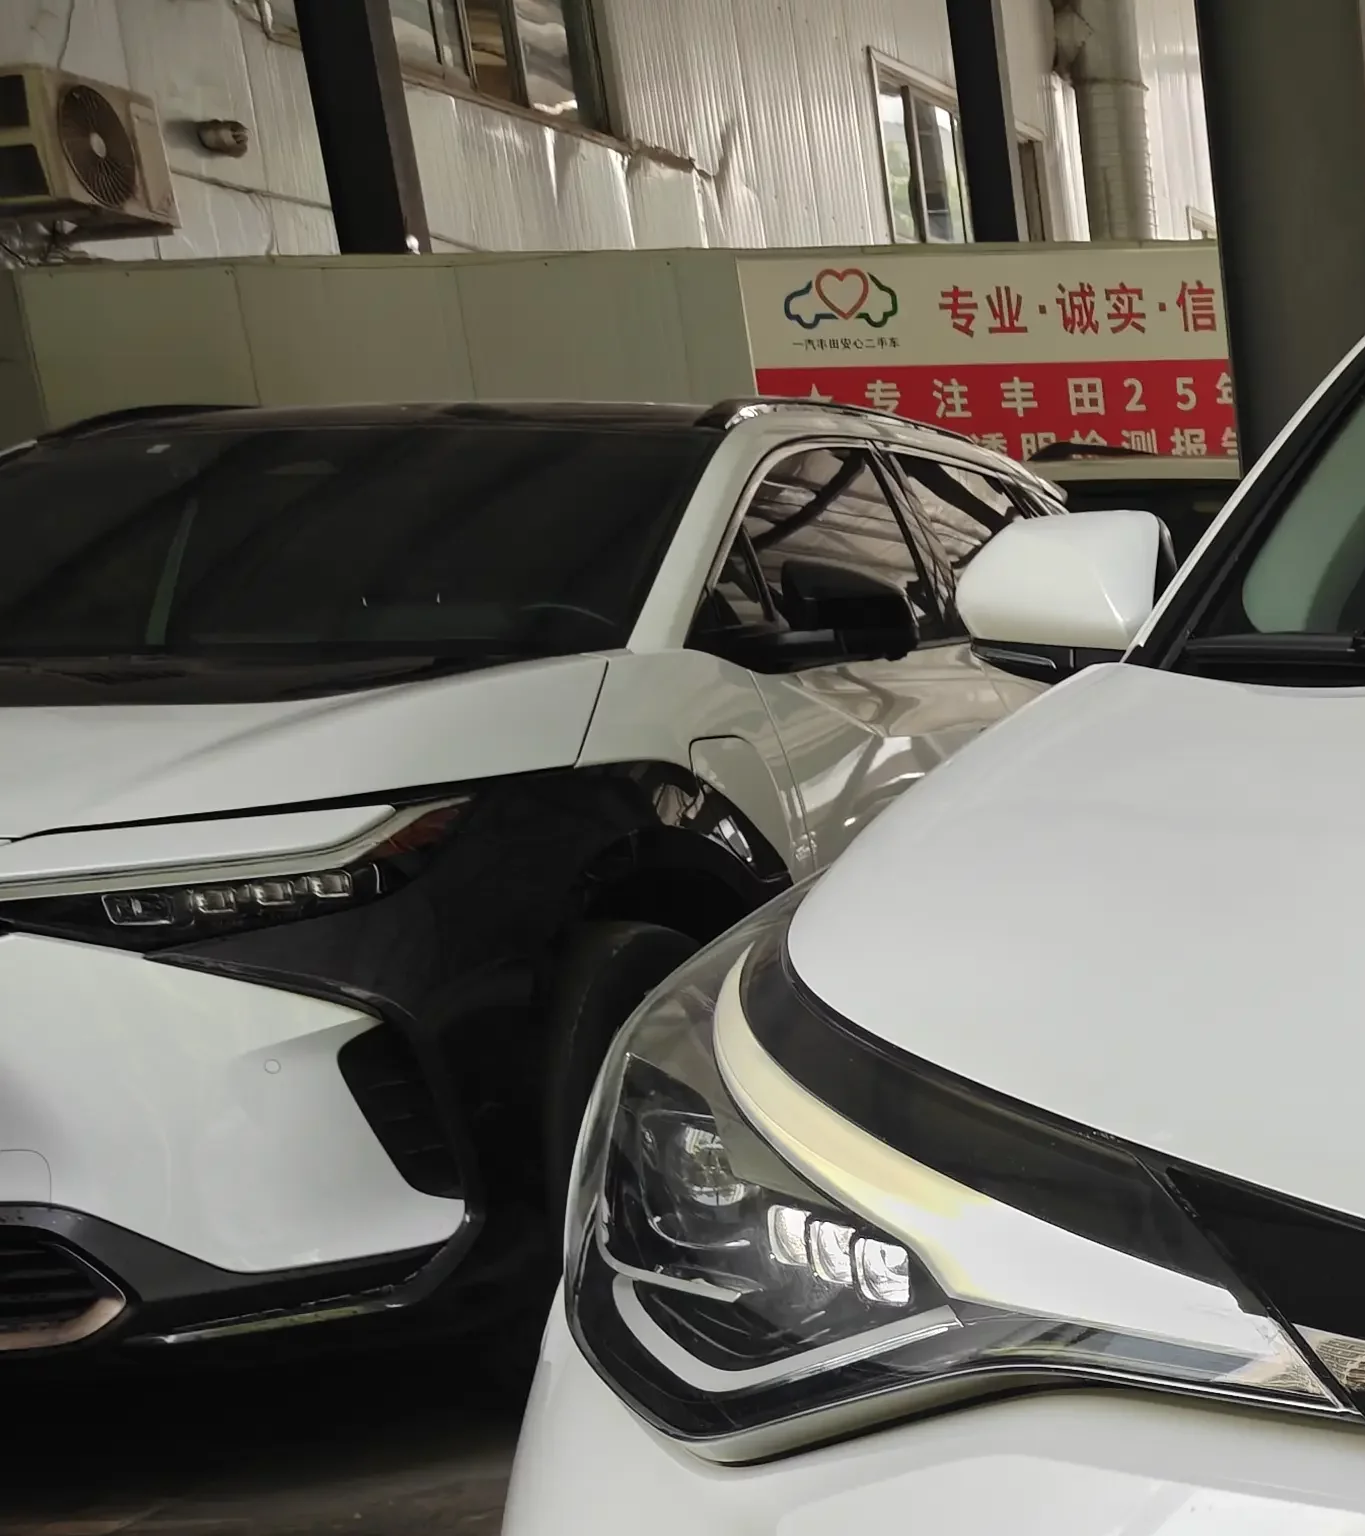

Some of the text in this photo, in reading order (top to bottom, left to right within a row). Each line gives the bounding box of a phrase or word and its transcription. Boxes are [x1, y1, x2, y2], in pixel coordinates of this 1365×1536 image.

[792, 337, 901, 351] 一汽丰田安心二手车
